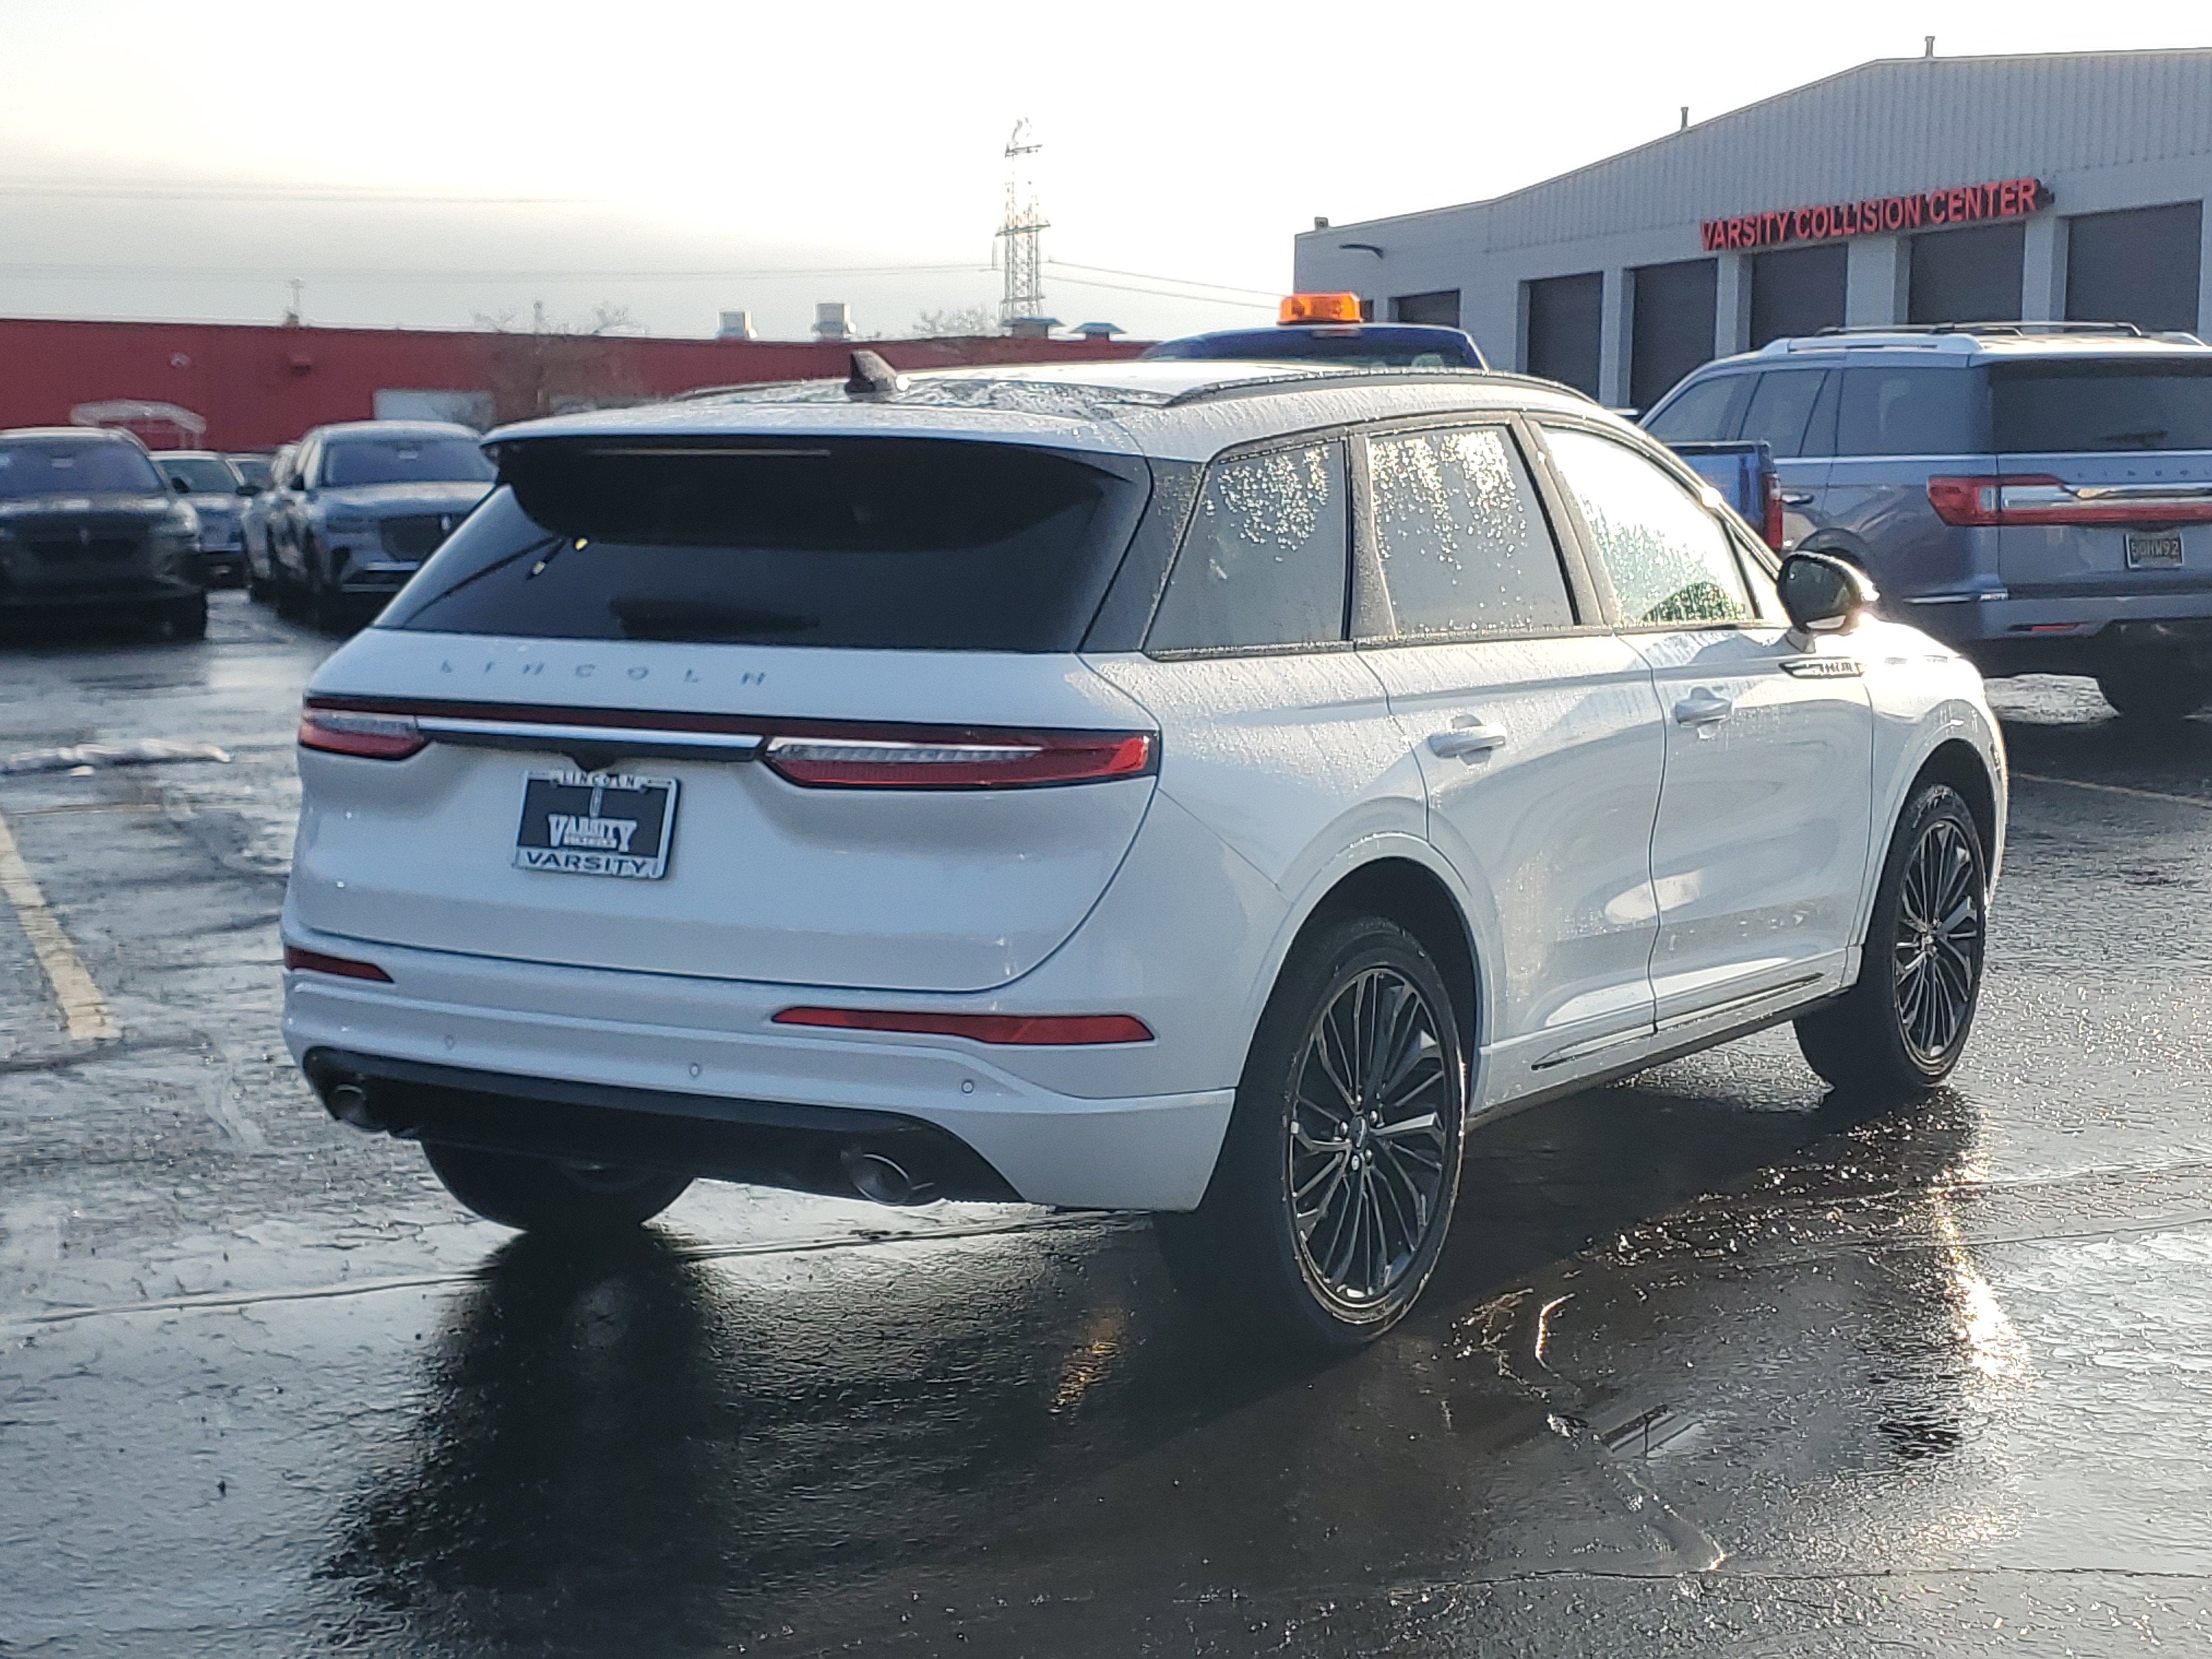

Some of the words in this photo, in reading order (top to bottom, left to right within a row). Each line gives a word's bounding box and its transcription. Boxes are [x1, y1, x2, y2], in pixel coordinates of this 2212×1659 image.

[1700, 212, 1790, 250] VARSITY
[1795, 194, 1921, 240] COLLISION
[1928, 177, 2037, 224] CENTER
[441, 661, 765, 686] LINCOLN
[526, 851, 647, 874] VARSITY
